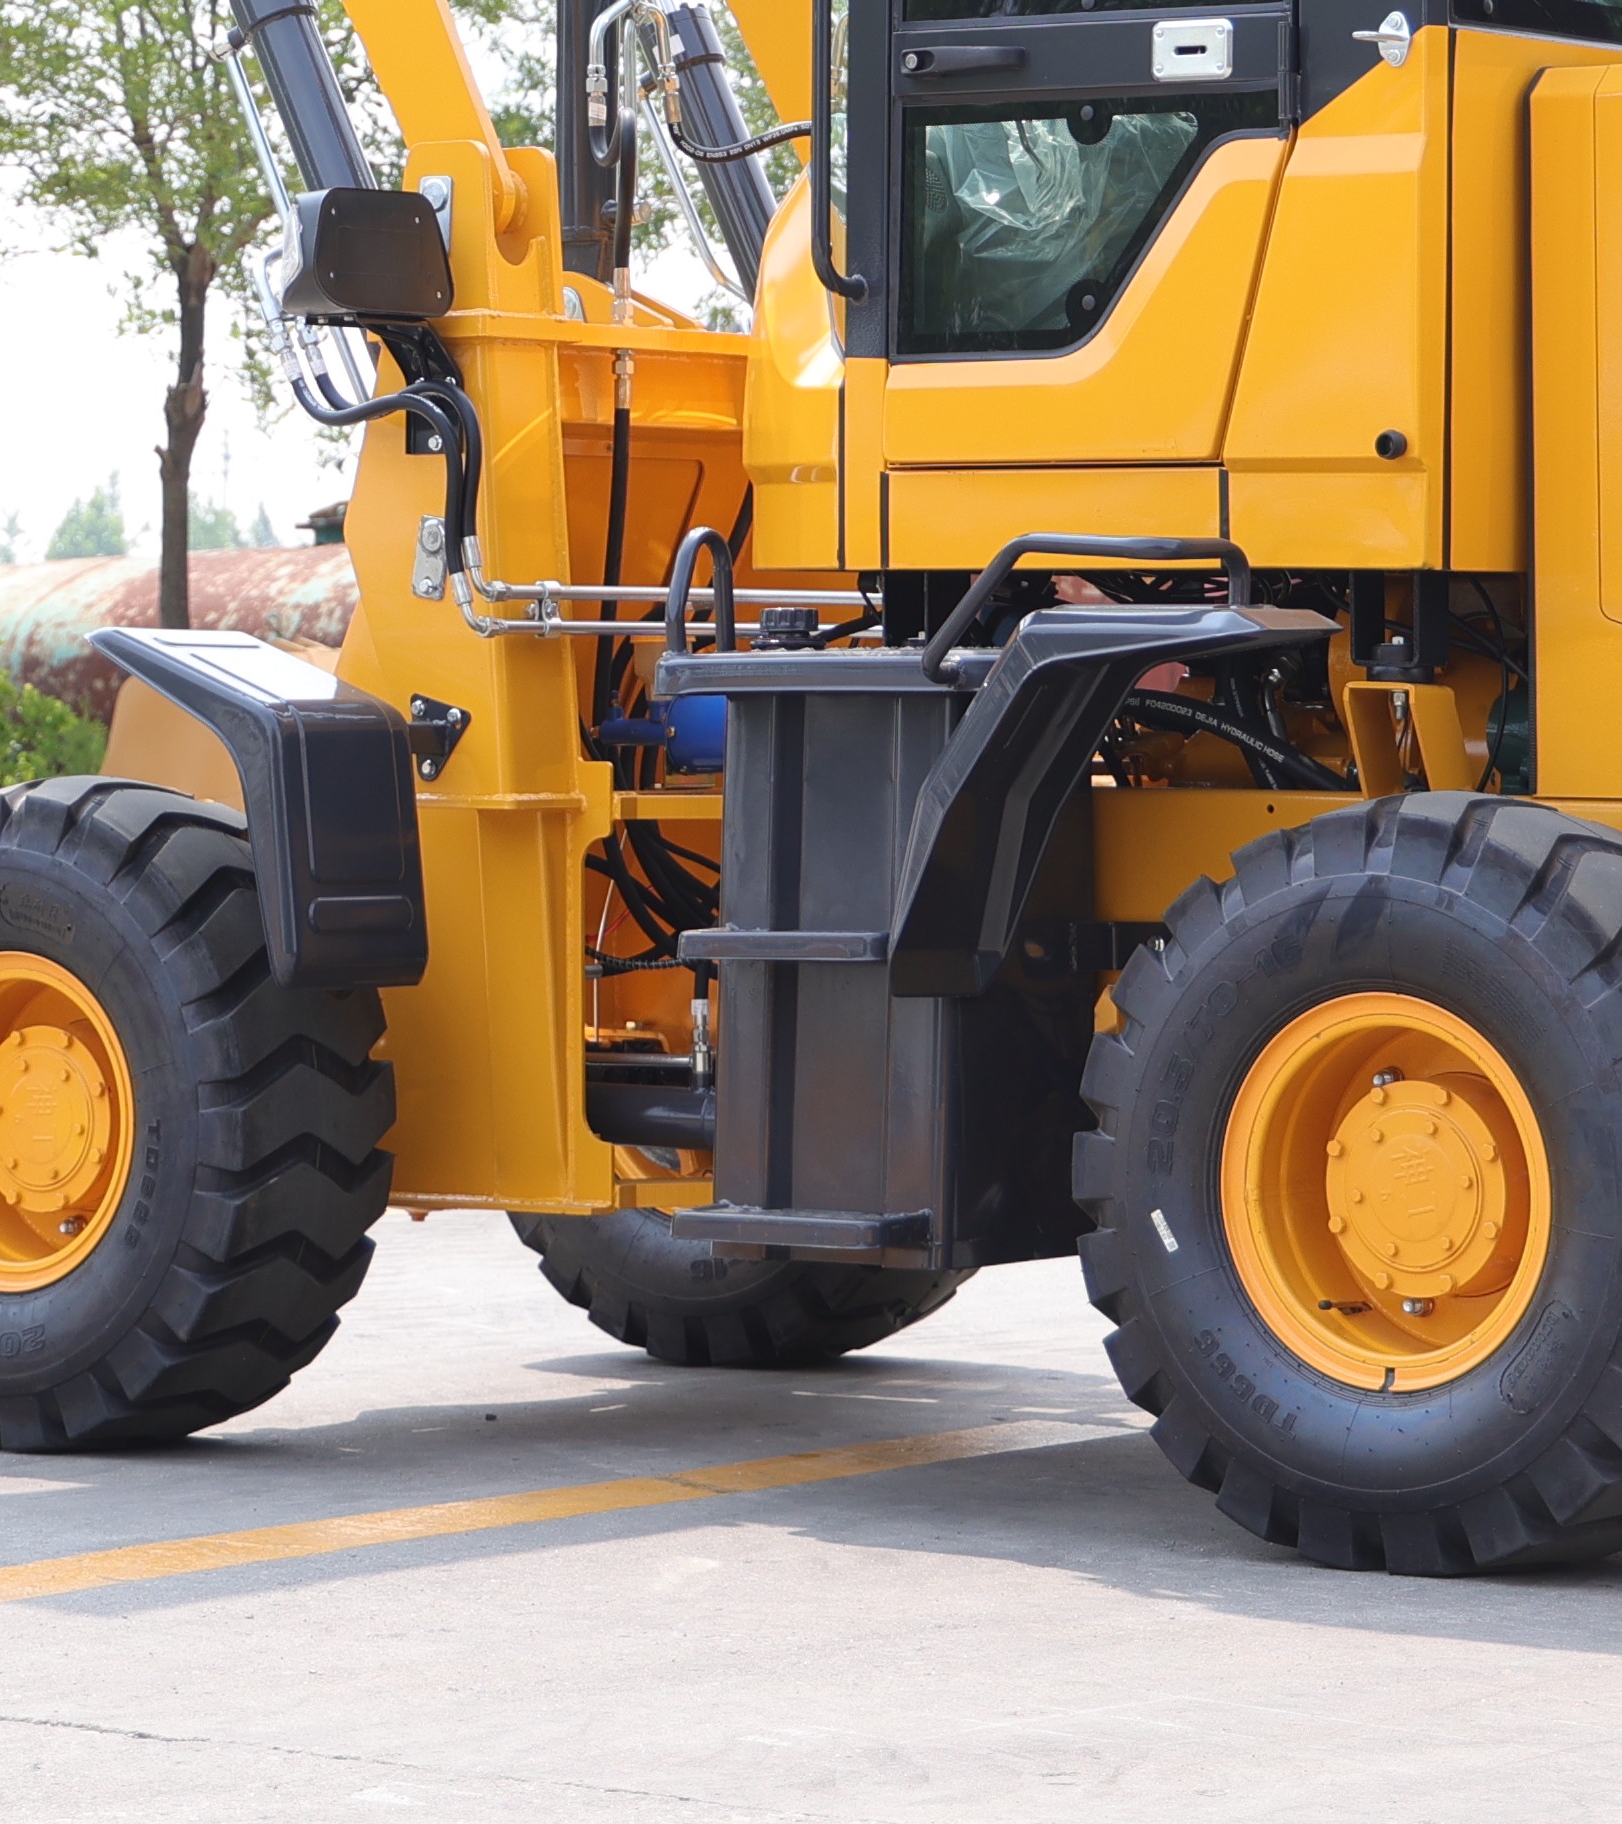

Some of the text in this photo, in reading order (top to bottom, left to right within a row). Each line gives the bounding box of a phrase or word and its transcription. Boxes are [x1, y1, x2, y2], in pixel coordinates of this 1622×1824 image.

[1195, 711, 1218, 727] DEJIA
[1220, 722, 1263, 751] HYDRAULIC
[1263, 744, 1286, 764] HOSE
[1194, 1328, 1298, 1442] TD666
